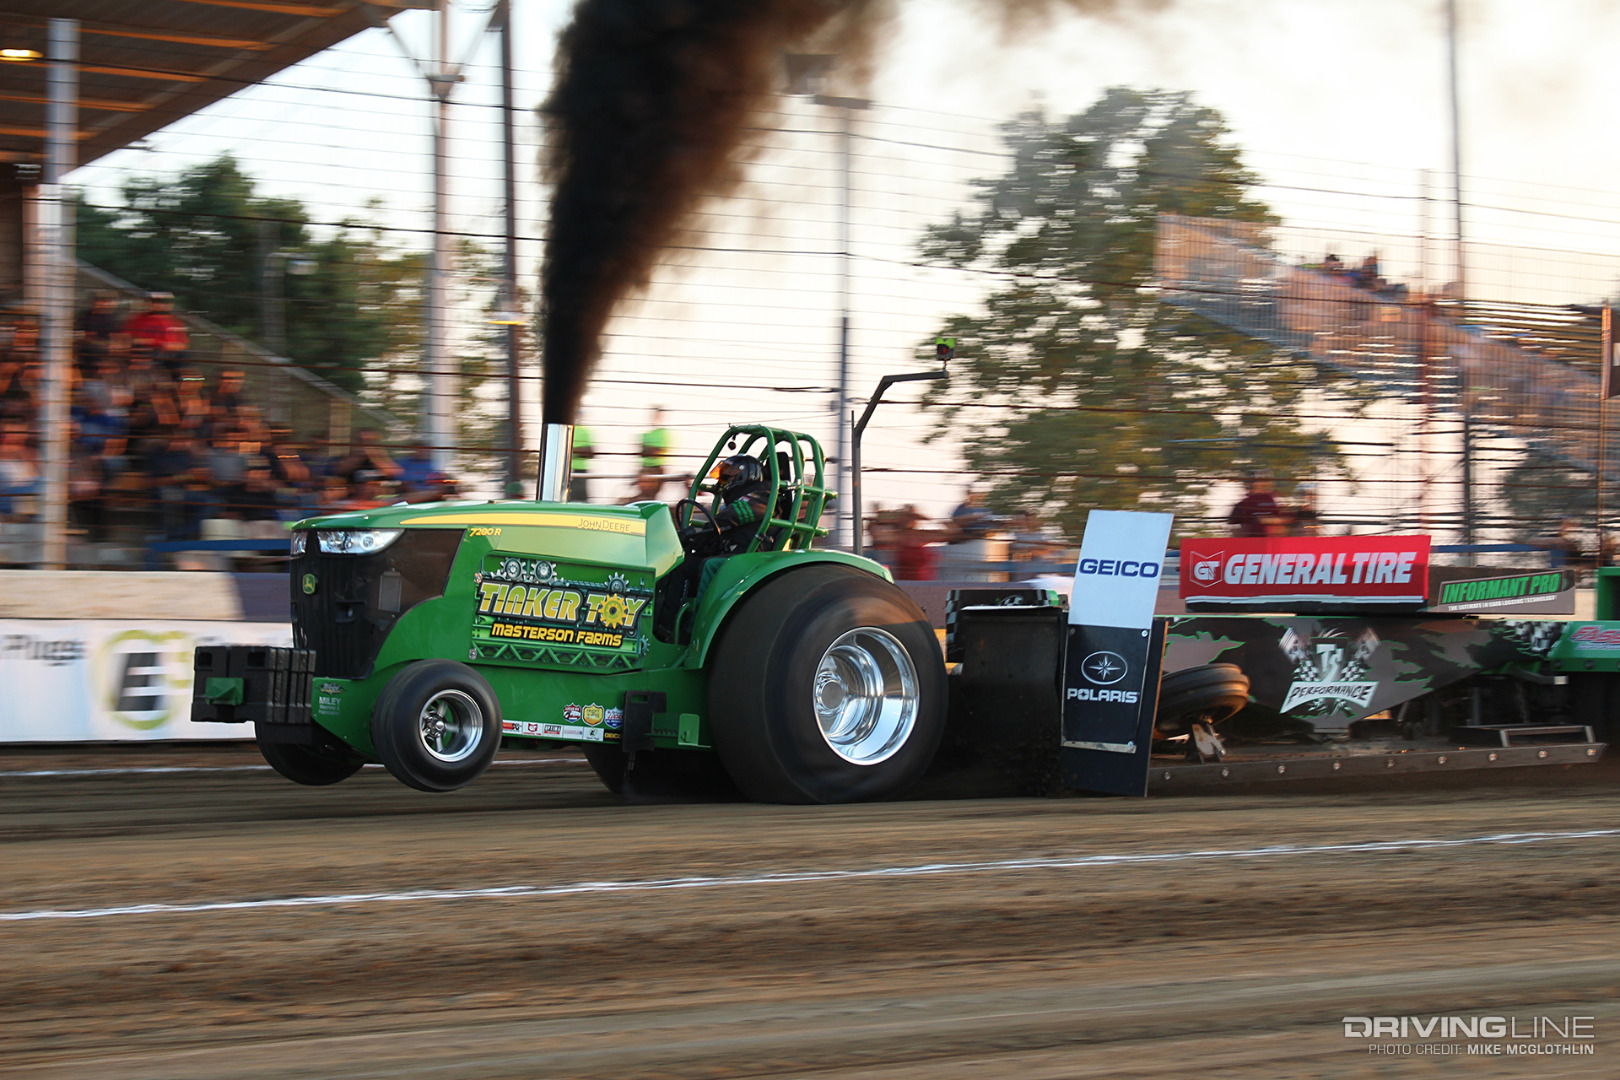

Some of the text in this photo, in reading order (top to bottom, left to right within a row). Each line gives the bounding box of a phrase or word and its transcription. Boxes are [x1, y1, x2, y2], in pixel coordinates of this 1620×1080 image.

[469, 527, 502, 538] 7280 R
[577, 517, 630, 533] JOHN DEERE
[1078, 558, 1160, 578] GEICO
[1223, 553, 1349, 585] GENERAL
[1351, 551, 1418, 585] TIRE
[1441, 572, 1562, 604] INFORMANT PRO
[479, 581, 582, 622] TINKER
[491, 622, 623, 647] MASTERSON FARMS
[318, 696, 341, 706] MILEY
[1067, 687, 1138, 704] POLARIS
[1287, 684, 1374, 704] PERFORMANCE
